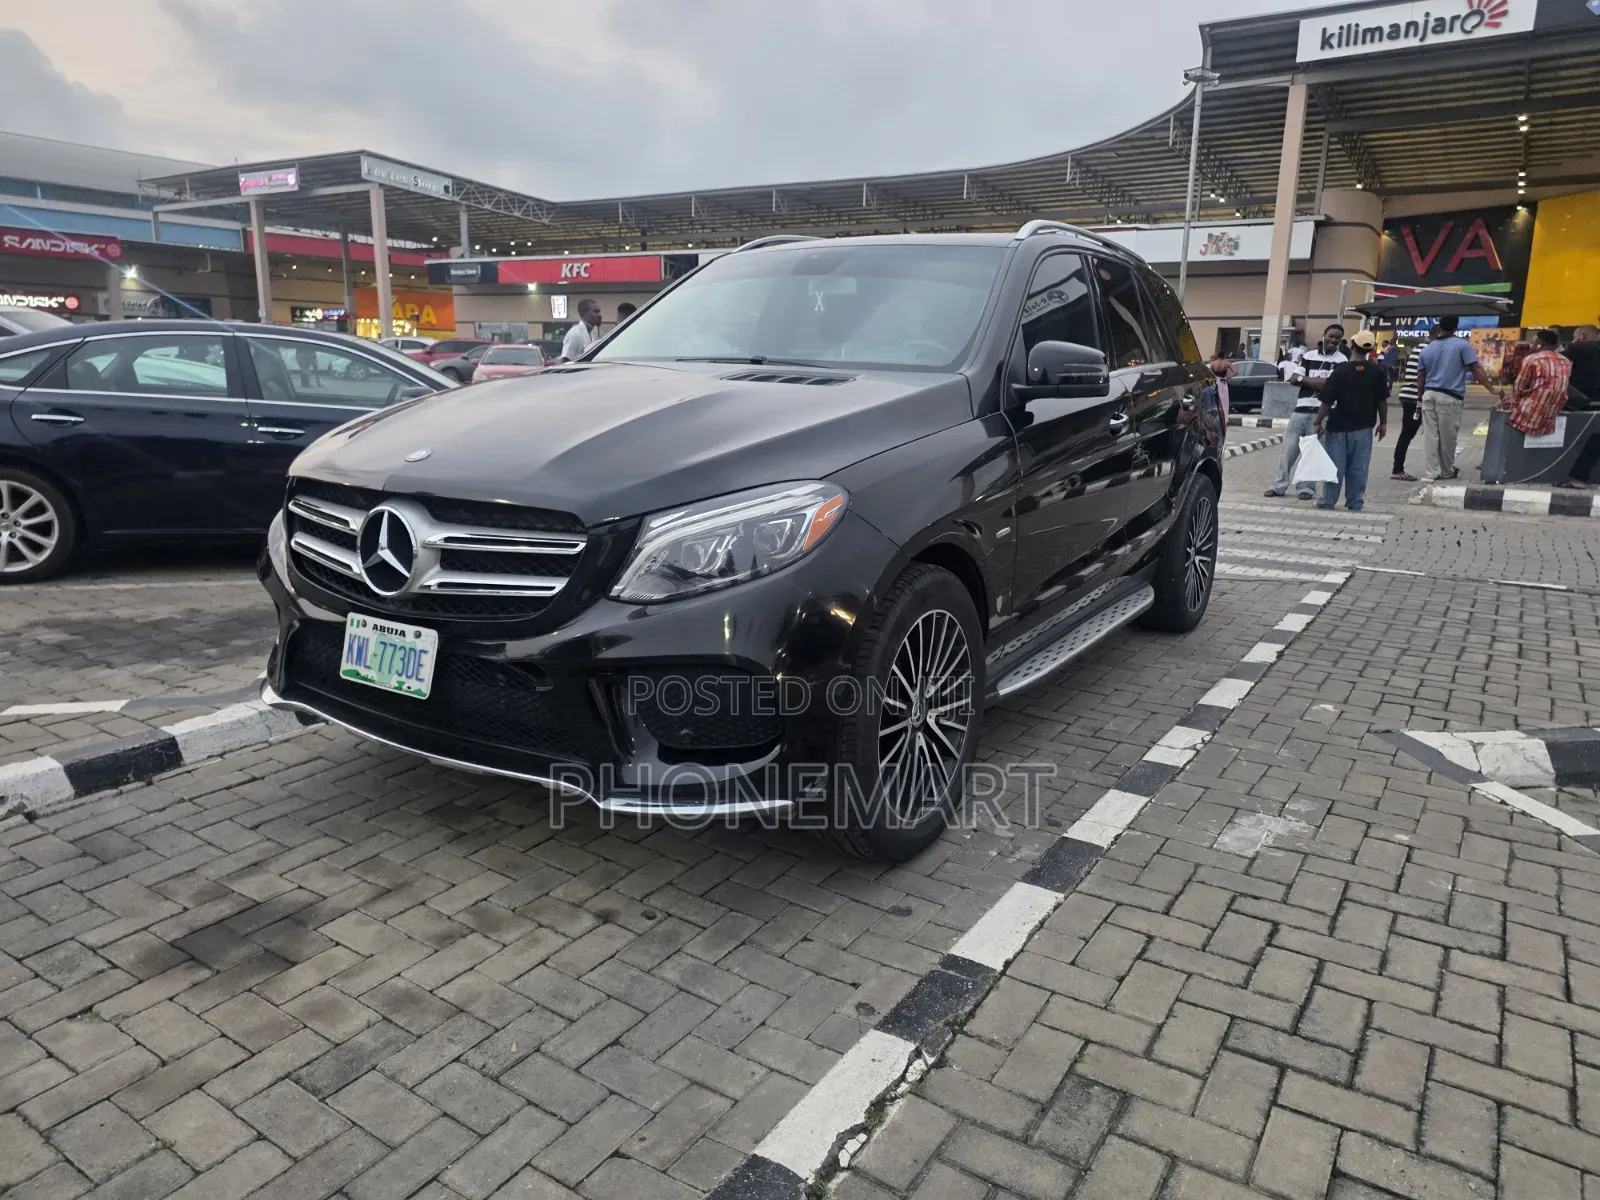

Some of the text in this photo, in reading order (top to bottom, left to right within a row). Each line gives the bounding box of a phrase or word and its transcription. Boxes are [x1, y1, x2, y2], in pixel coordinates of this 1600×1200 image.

[561, 262, 591, 278] KFC
[1396, 330, 1430, 338] TICKETS
[372, 623, 406, 638] ABUJA
